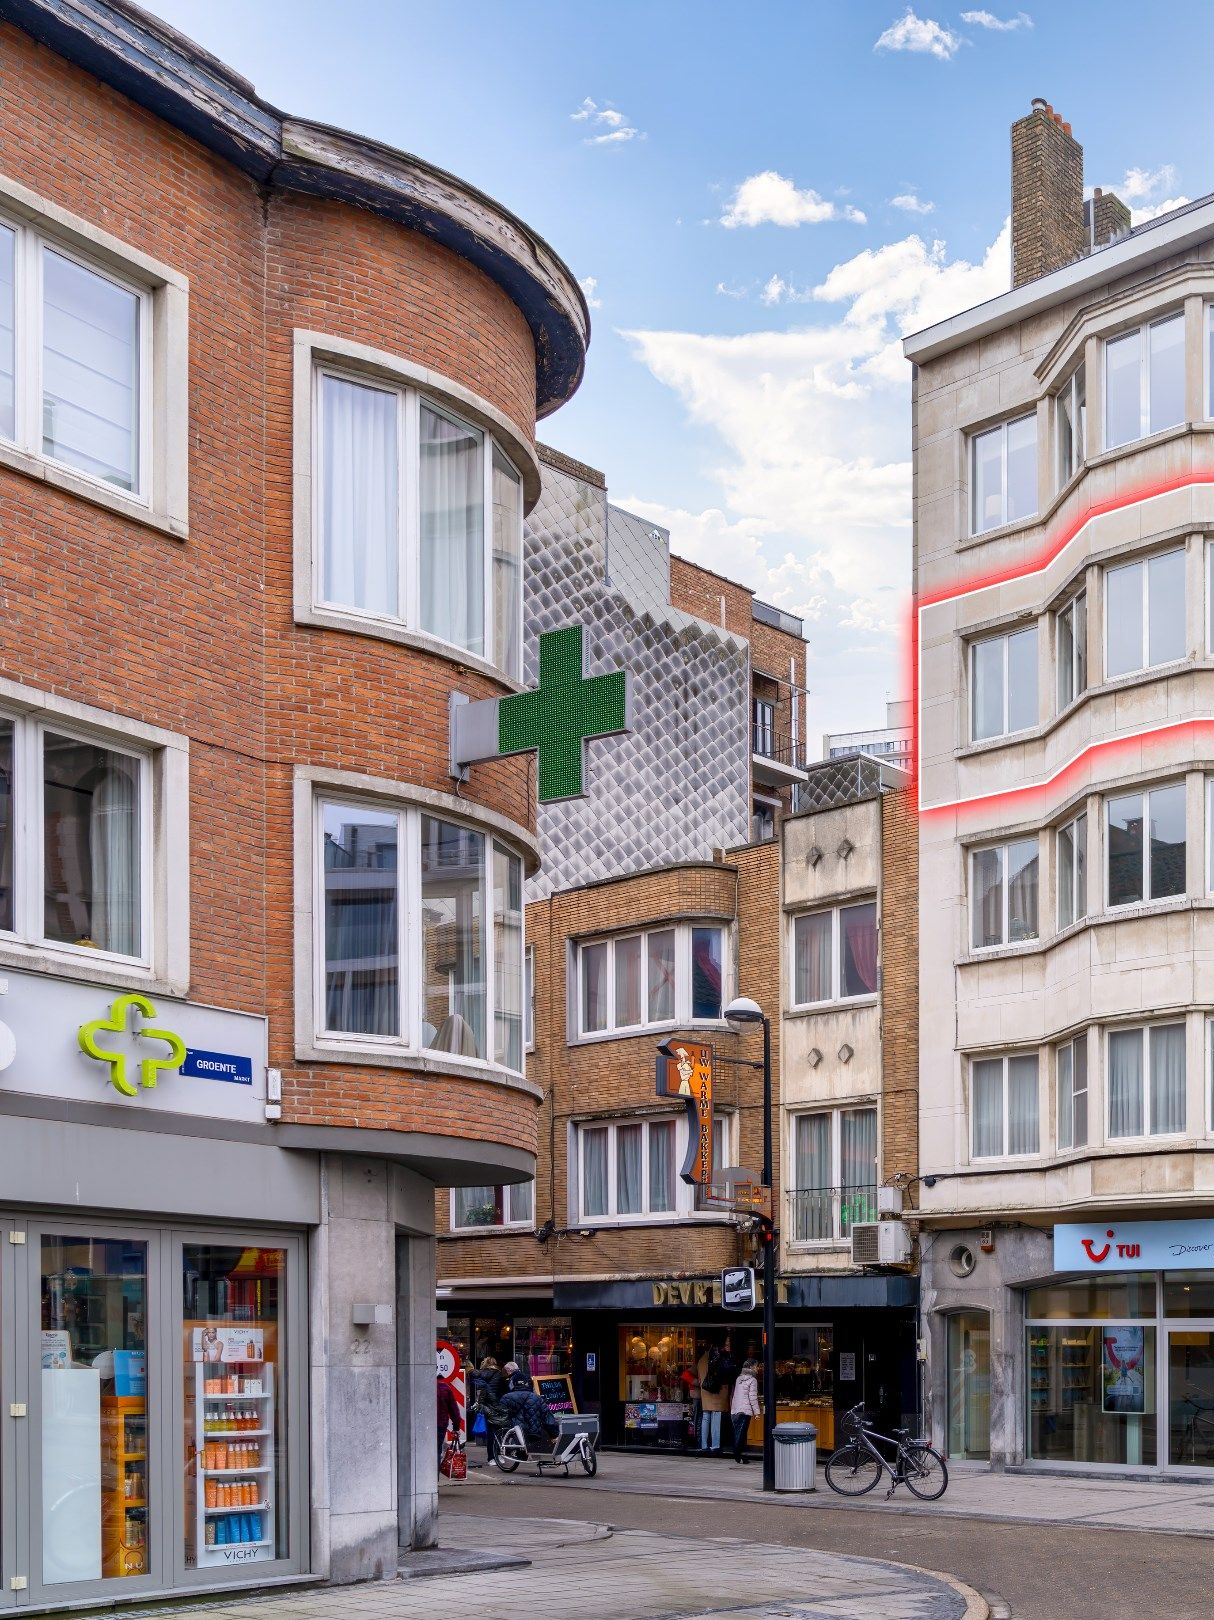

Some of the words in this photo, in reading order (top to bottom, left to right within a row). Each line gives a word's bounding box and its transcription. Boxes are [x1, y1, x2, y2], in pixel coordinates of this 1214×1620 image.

[700, 1050, 709, 1067] UW
[197, 1060, 236, 1073] GROENTE
[700, 1072, 709, 1118] WARME
[1116, 1244, 1140, 1258] TUI
[224, 1549, 258, 1559] VICHY
